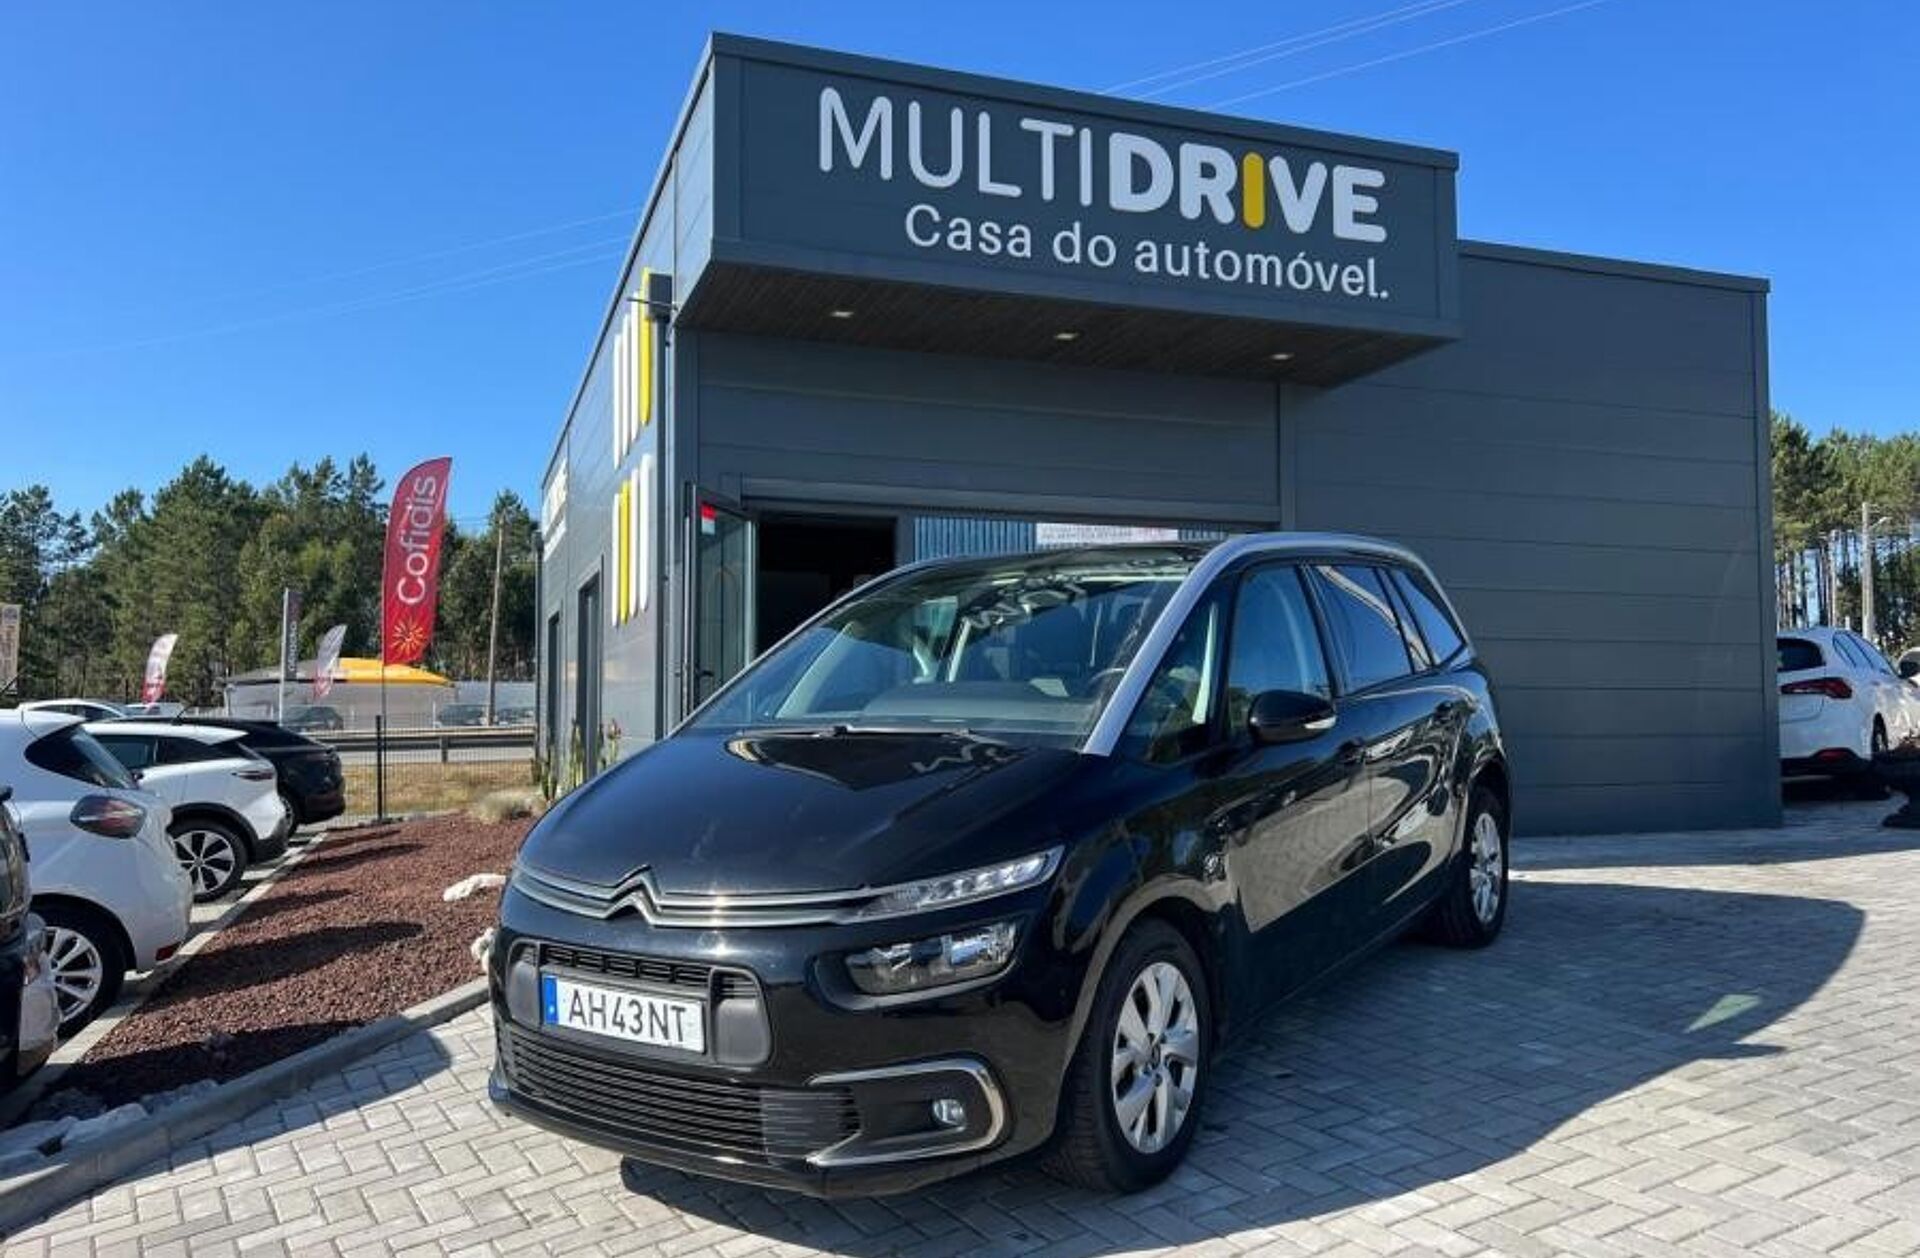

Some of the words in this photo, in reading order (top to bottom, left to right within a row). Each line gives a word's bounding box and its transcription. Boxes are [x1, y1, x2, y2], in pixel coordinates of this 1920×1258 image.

[818, 87, 1388, 242] MULTIDRIVE
[904, 203, 1032, 259] Casa
[1052, 220, 1117, 267] do
[1133, 238, 1390, 299] automóvel.
[396, 475, 437, 606] Cofidis
